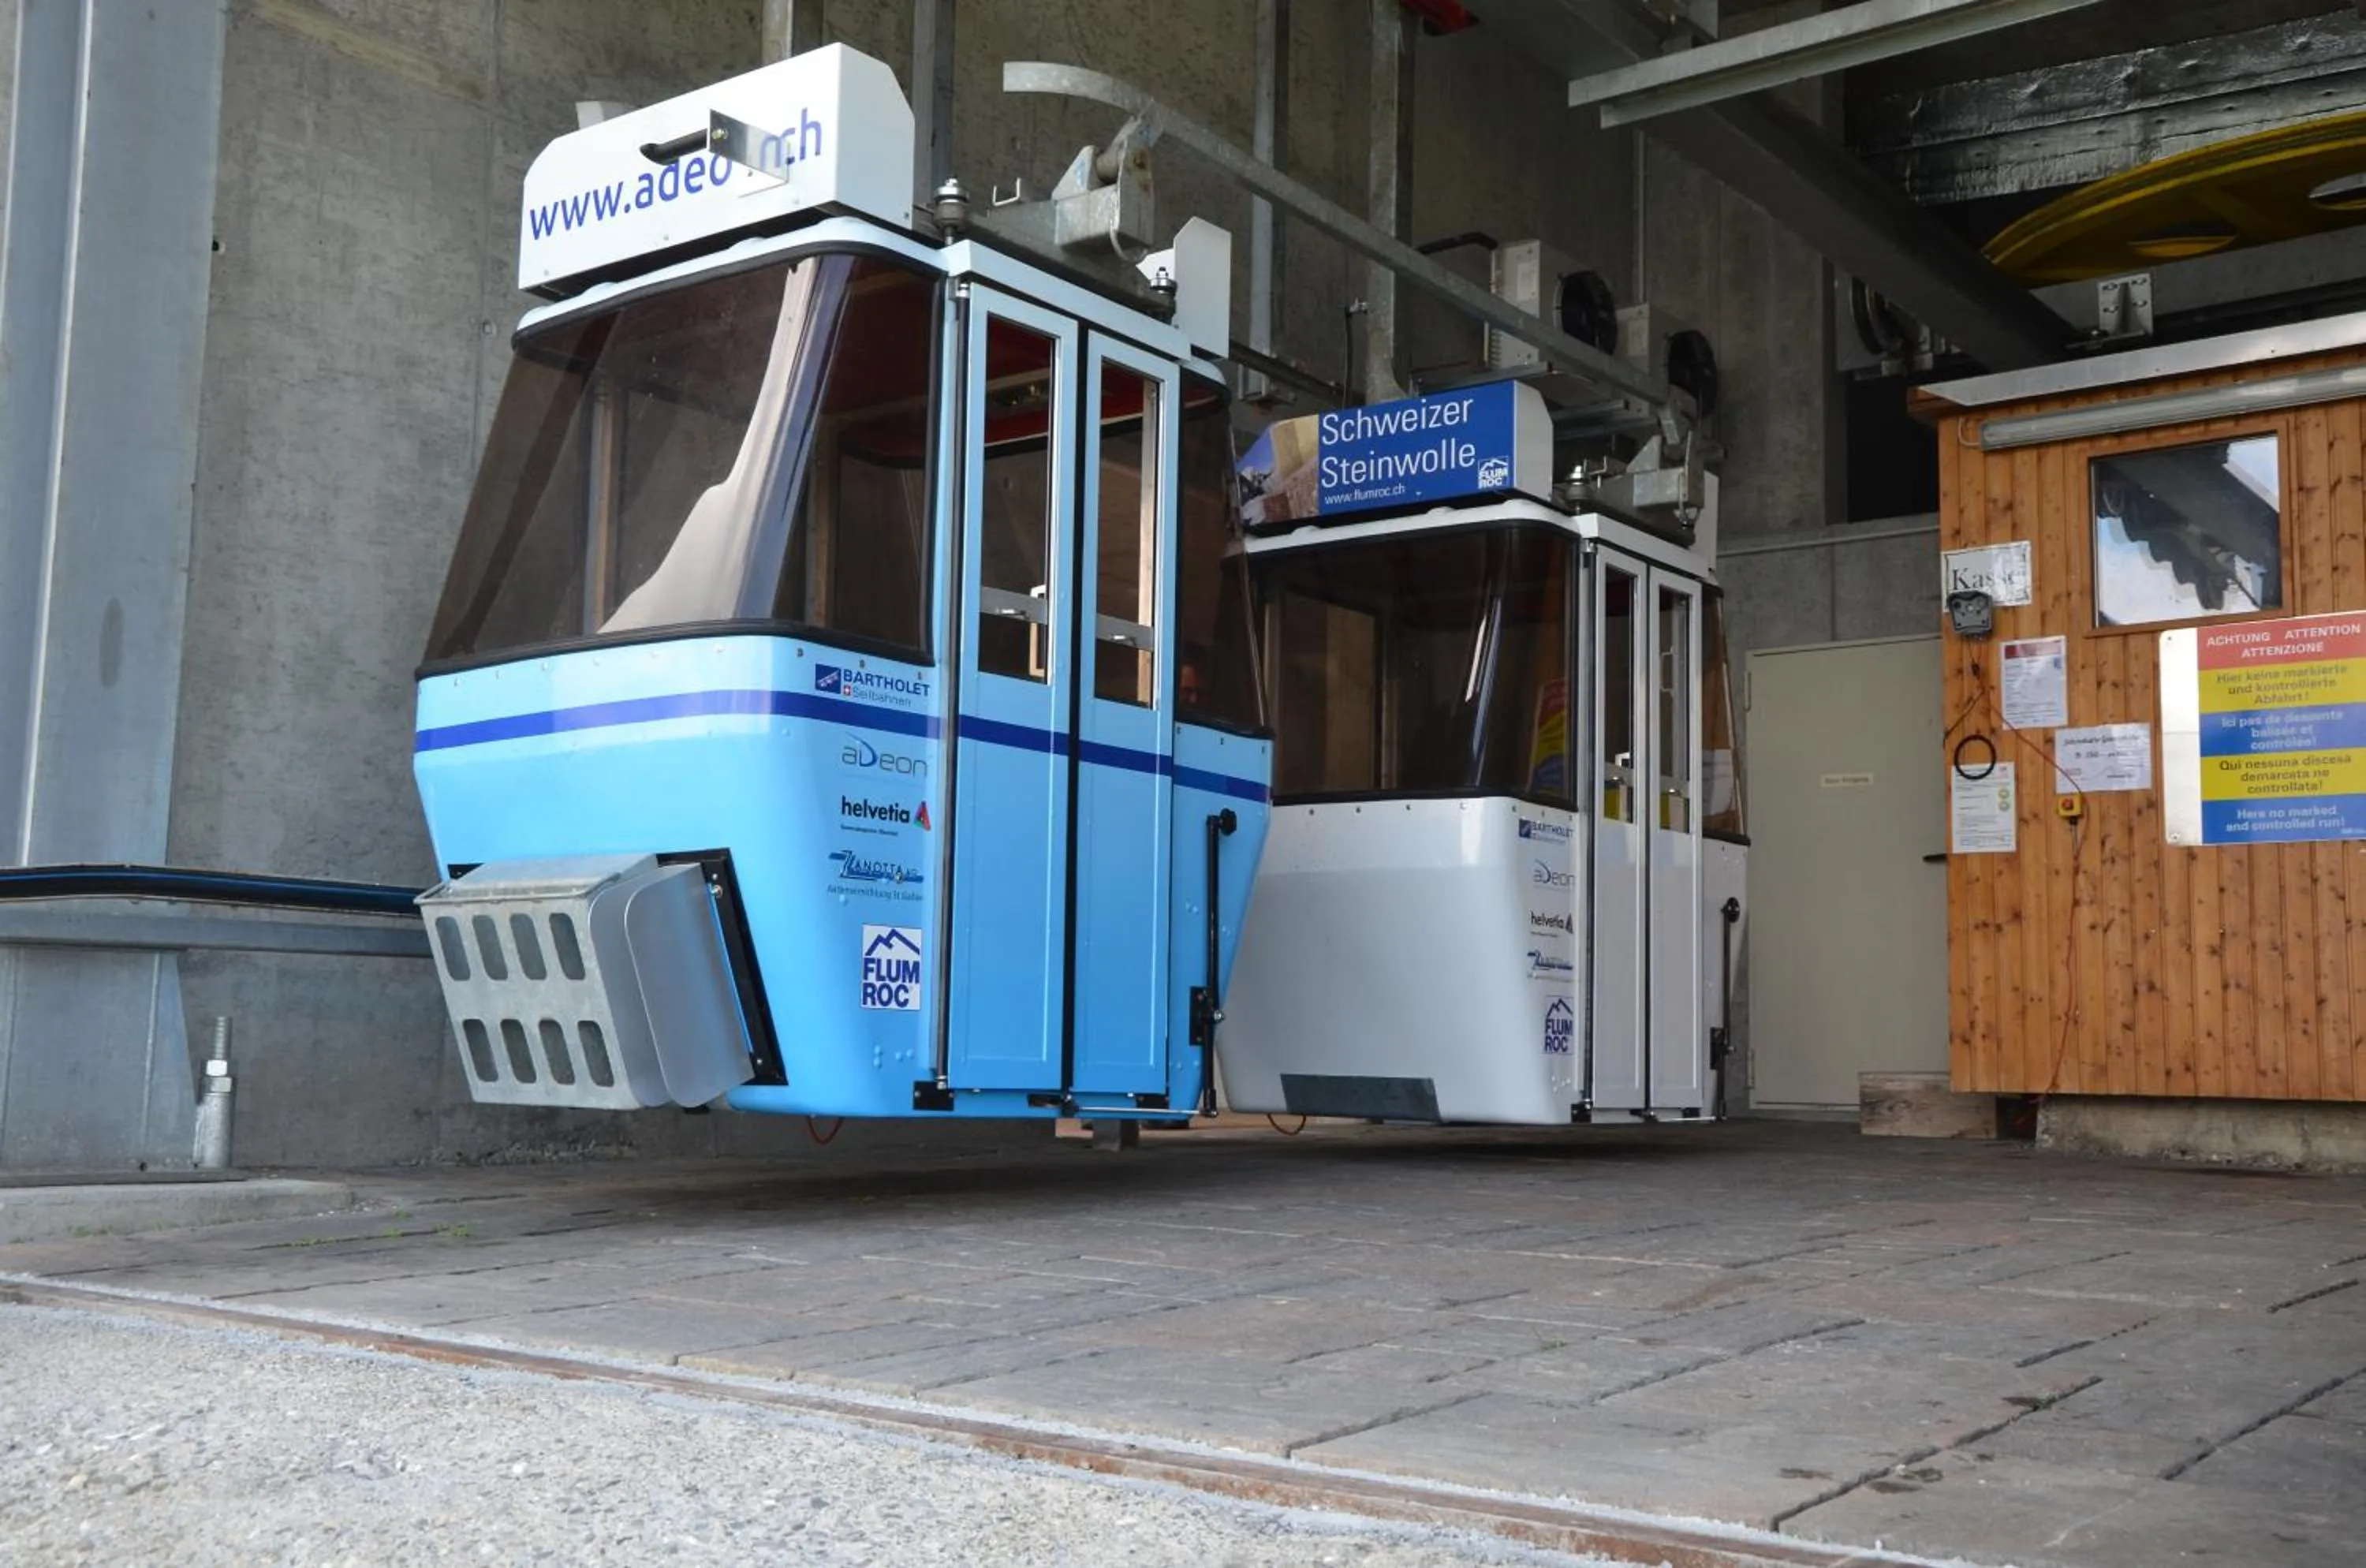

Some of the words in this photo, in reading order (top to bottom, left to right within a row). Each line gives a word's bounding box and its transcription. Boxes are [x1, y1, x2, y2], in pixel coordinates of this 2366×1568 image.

[530, 107, 822, 241] www.adeoch
[1322, 398, 1474, 446] Schweizer
[1322, 438, 1476, 488] Steinwolle
[1478, 467, 1508, 480] FLUM
[1478, 476, 1503, 489] ROC
[1325, 483, 1406, 505] www.flumroc.ch
[1953, 567, 2015, 591] Kas
[2206, 632, 2271, 648] ACHTUNG
[2285, 624, 2360, 640] ATTENTION
[2241, 641, 2324, 659] ATTENZIONE
[843, 669, 931, 696] BARTHOLET
[2217, 673, 2242, 684] Hier
[2246, 670, 2281, 681] keine
[2284, 664, 2348, 677] markierte
[2228, 685, 2253, 695] und
[2256, 678, 2337, 693] kontrollierte
[853, 685, 912, 707] Seilbahnen
[2222, 717, 2237, 728] Ici
[2239, 717, 2263, 729] pas
[2266, 714, 2282, 725] de
[2300, 724, 2314, 735] et
[2219, 760, 2242, 771] Qui
[2245, 757, 2299, 770] nessuna
[2301, 754, 2352, 767] discesa
[2241, 770, 2310, 782] demarcata
[2246, 781, 2323, 794] controllata!
[841, 795, 910, 823] helvetia
[2237, 808, 2266, 819] Here
[2269, 809, 2286, 819] no
[2289, 805, 2337, 817] marked
[2226, 821, 2248, 832] and
[2252, 818, 2316, 831] controlled
[2319, 816, 2345, 827] run!
[1531, 910, 1564, 929] helvetia
[863, 957, 920, 984] FLUM
[862, 982, 909, 1008] ROC
[1545, 1018, 1573, 1036] FLUM
[1545, 1036, 1569, 1053] ROC
